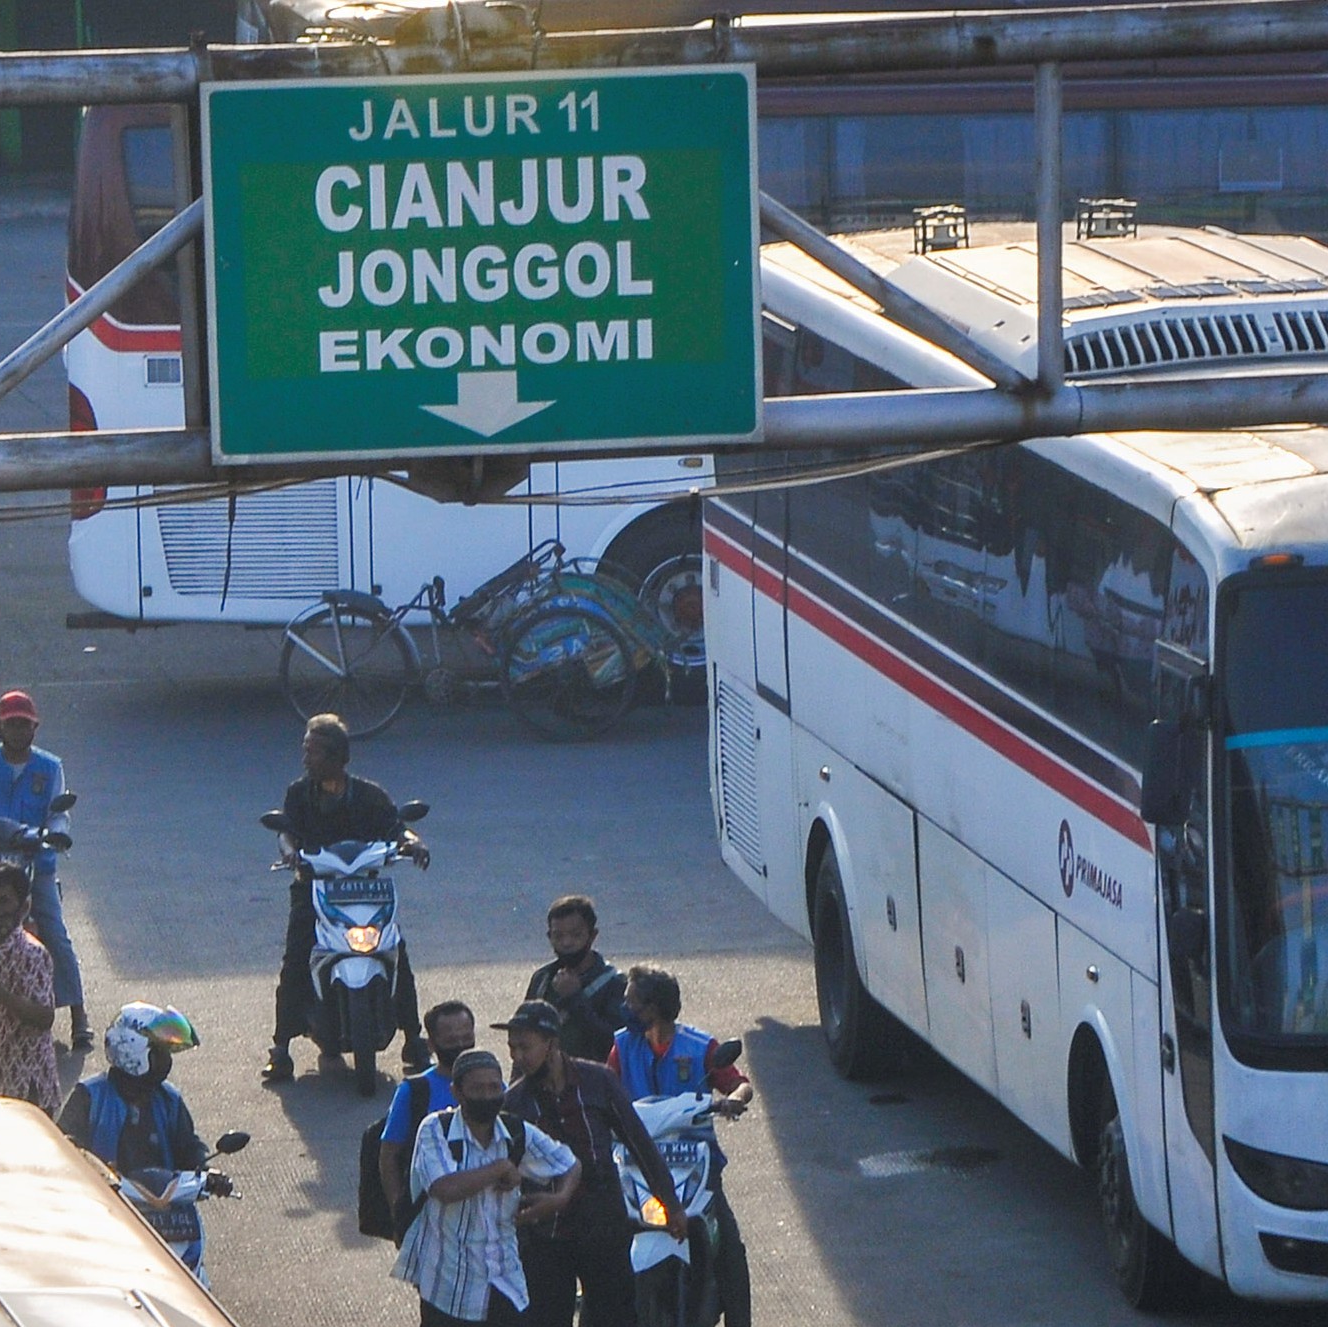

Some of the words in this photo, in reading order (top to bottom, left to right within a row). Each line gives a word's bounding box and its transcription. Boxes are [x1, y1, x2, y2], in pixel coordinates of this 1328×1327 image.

[348, 93, 540, 141] JALUR
[558, 90, 600, 132] 11
[315, 155, 651, 232] CIANJUR
[318, 240, 654, 308] JONGGOL
[319, 318, 653, 372] EKONOMI
[1076, 854, 1122, 910] PRIMAJASA
